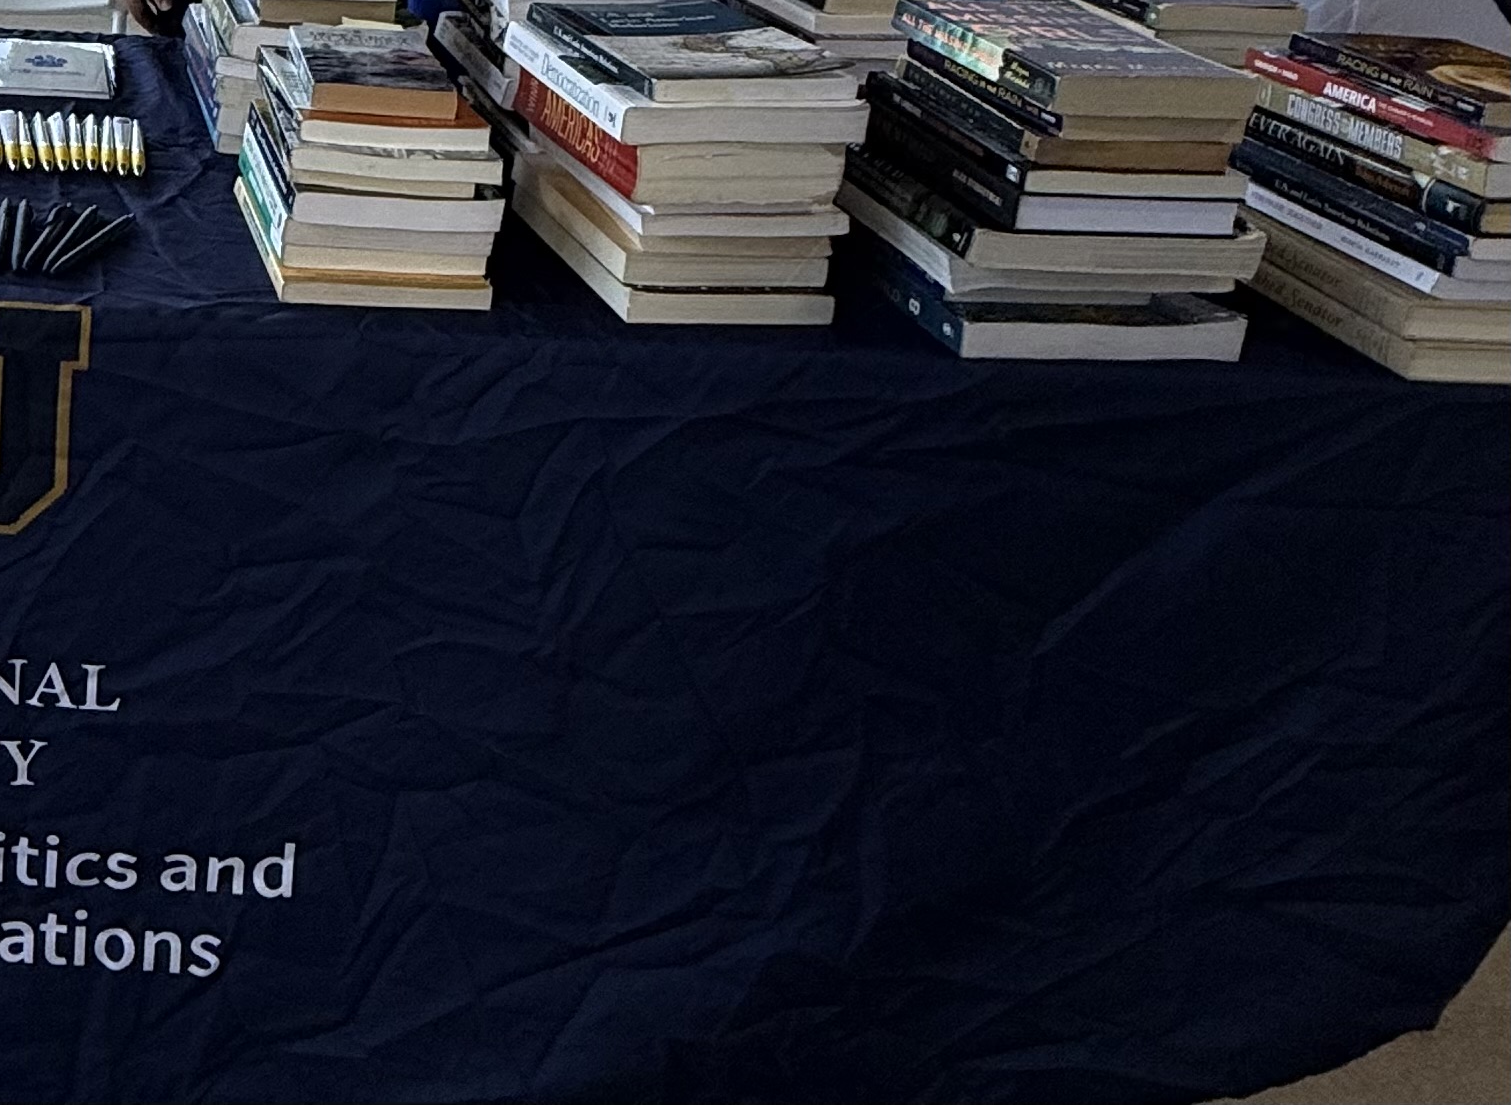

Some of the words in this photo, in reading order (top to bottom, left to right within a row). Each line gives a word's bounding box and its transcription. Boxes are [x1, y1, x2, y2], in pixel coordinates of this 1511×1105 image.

[1322, 81, 1377, 113] AMERICA
[1337, 53, 1379, 77] RACING
[1403, 74, 1434, 98] RAIN
[540, 89, 603, 163] AMERICAS
[1248, 112, 1289, 142] EVER
[1289, 127, 1345, 165] AGAIN
[1287, 94, 1339, 136] CONGRESS
[1349, 116, 1403, 159] MEMBERS
[1290, 289, 1344, 327] Senator
[159, 841, 296, 898] and
